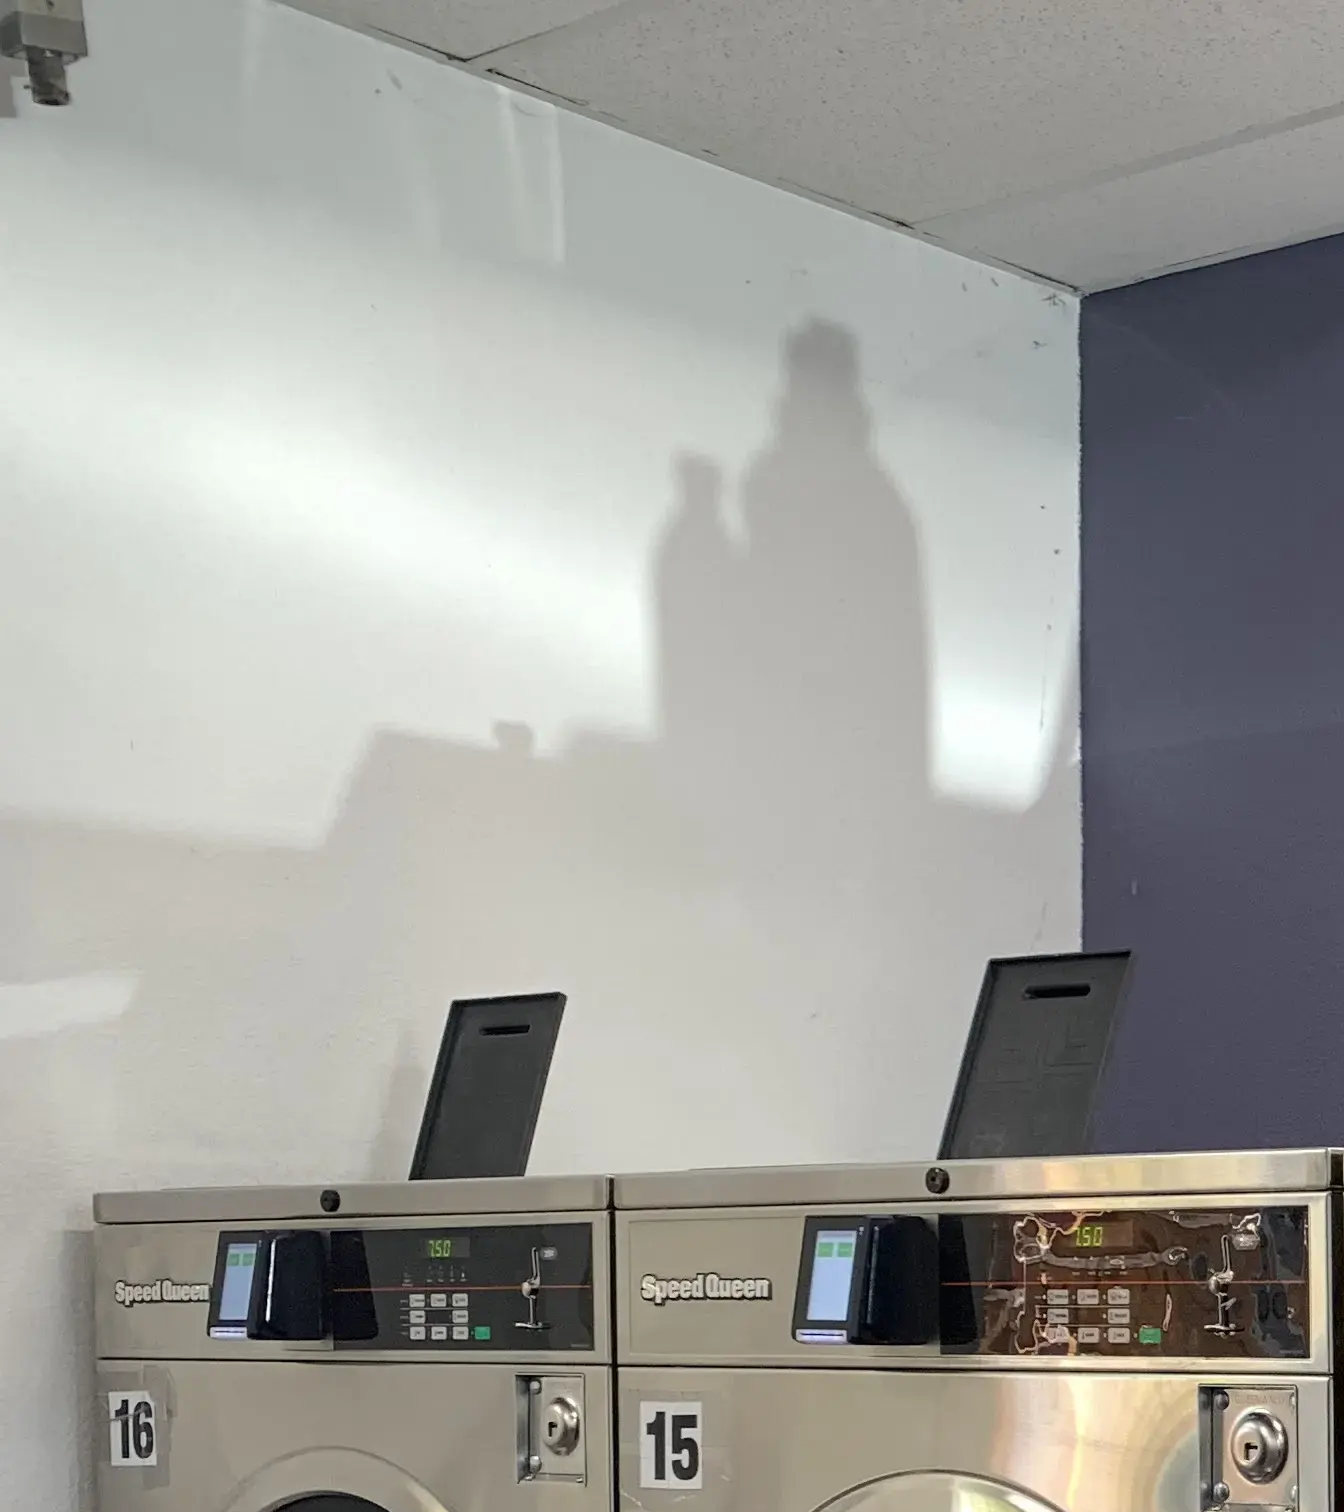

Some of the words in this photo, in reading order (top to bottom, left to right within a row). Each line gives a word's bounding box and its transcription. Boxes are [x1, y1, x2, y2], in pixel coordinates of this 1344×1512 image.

[115, 1280, 161, 1307] Speed
[162, 1279, 210, 1302] Queen
[640, 1273, 704, 1305] Speed
[705, 1272, 772, 1301] Queen
[114, 1398, 155, 1460] 16
[645, 1411, 699, 1481] 15
